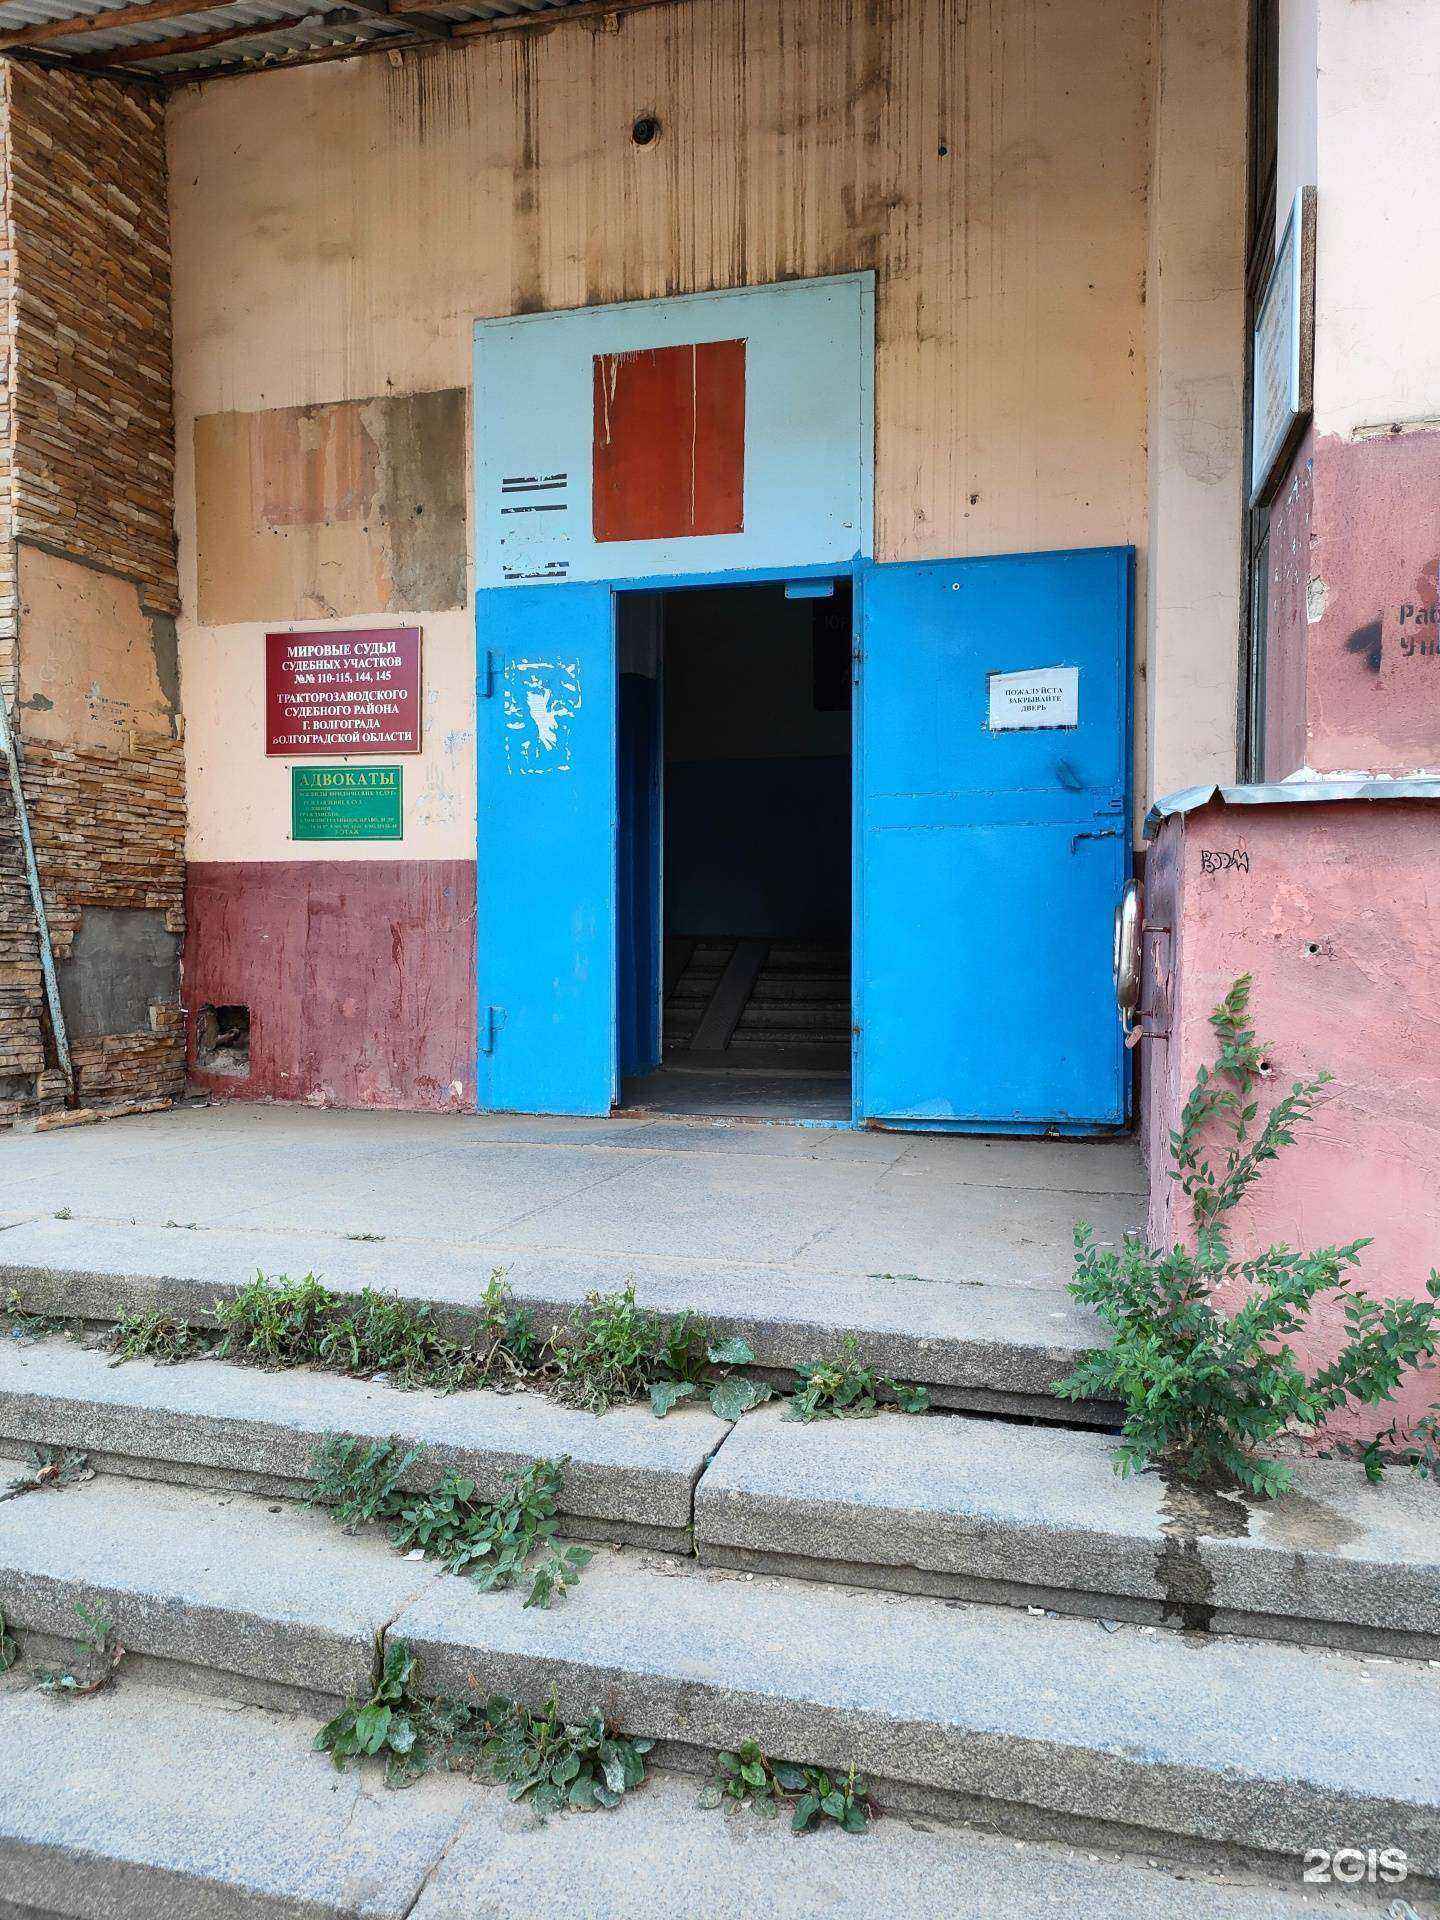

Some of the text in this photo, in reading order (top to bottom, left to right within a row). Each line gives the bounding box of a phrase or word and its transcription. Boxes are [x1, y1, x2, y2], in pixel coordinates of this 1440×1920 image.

[287, 641, 396, 658] МИРОВЫЕ СУДЬИ
[282, 657, 402, 672] СУДЕБНЫХ УЧАСТКОВ
[318, 672, 353, 684] 110-115,
[355, 671, 374, 683] 144,
[376, 670, 392, 681] 145
[277, 689, 408, 704] ТРАКТОРОЗАВОДСКОГО
[1004, 686, 1064, 696] ПОЖАЛУЙСТА
[1009, 695, 1062, 704] ЗАКРЫВАЙТЕ
[284, 703, 400, 719] СУДЕБНОГО РАЙОНА
[1020, 704, 1047, 712] ДВЕРЬ
[302, 718, 381, 731] Г. ВОЛГОГРАДА
[362, 731, 412, 743] ОБЛАСТИ
[300, 772, 395, 787] АДВОКАТЫ
